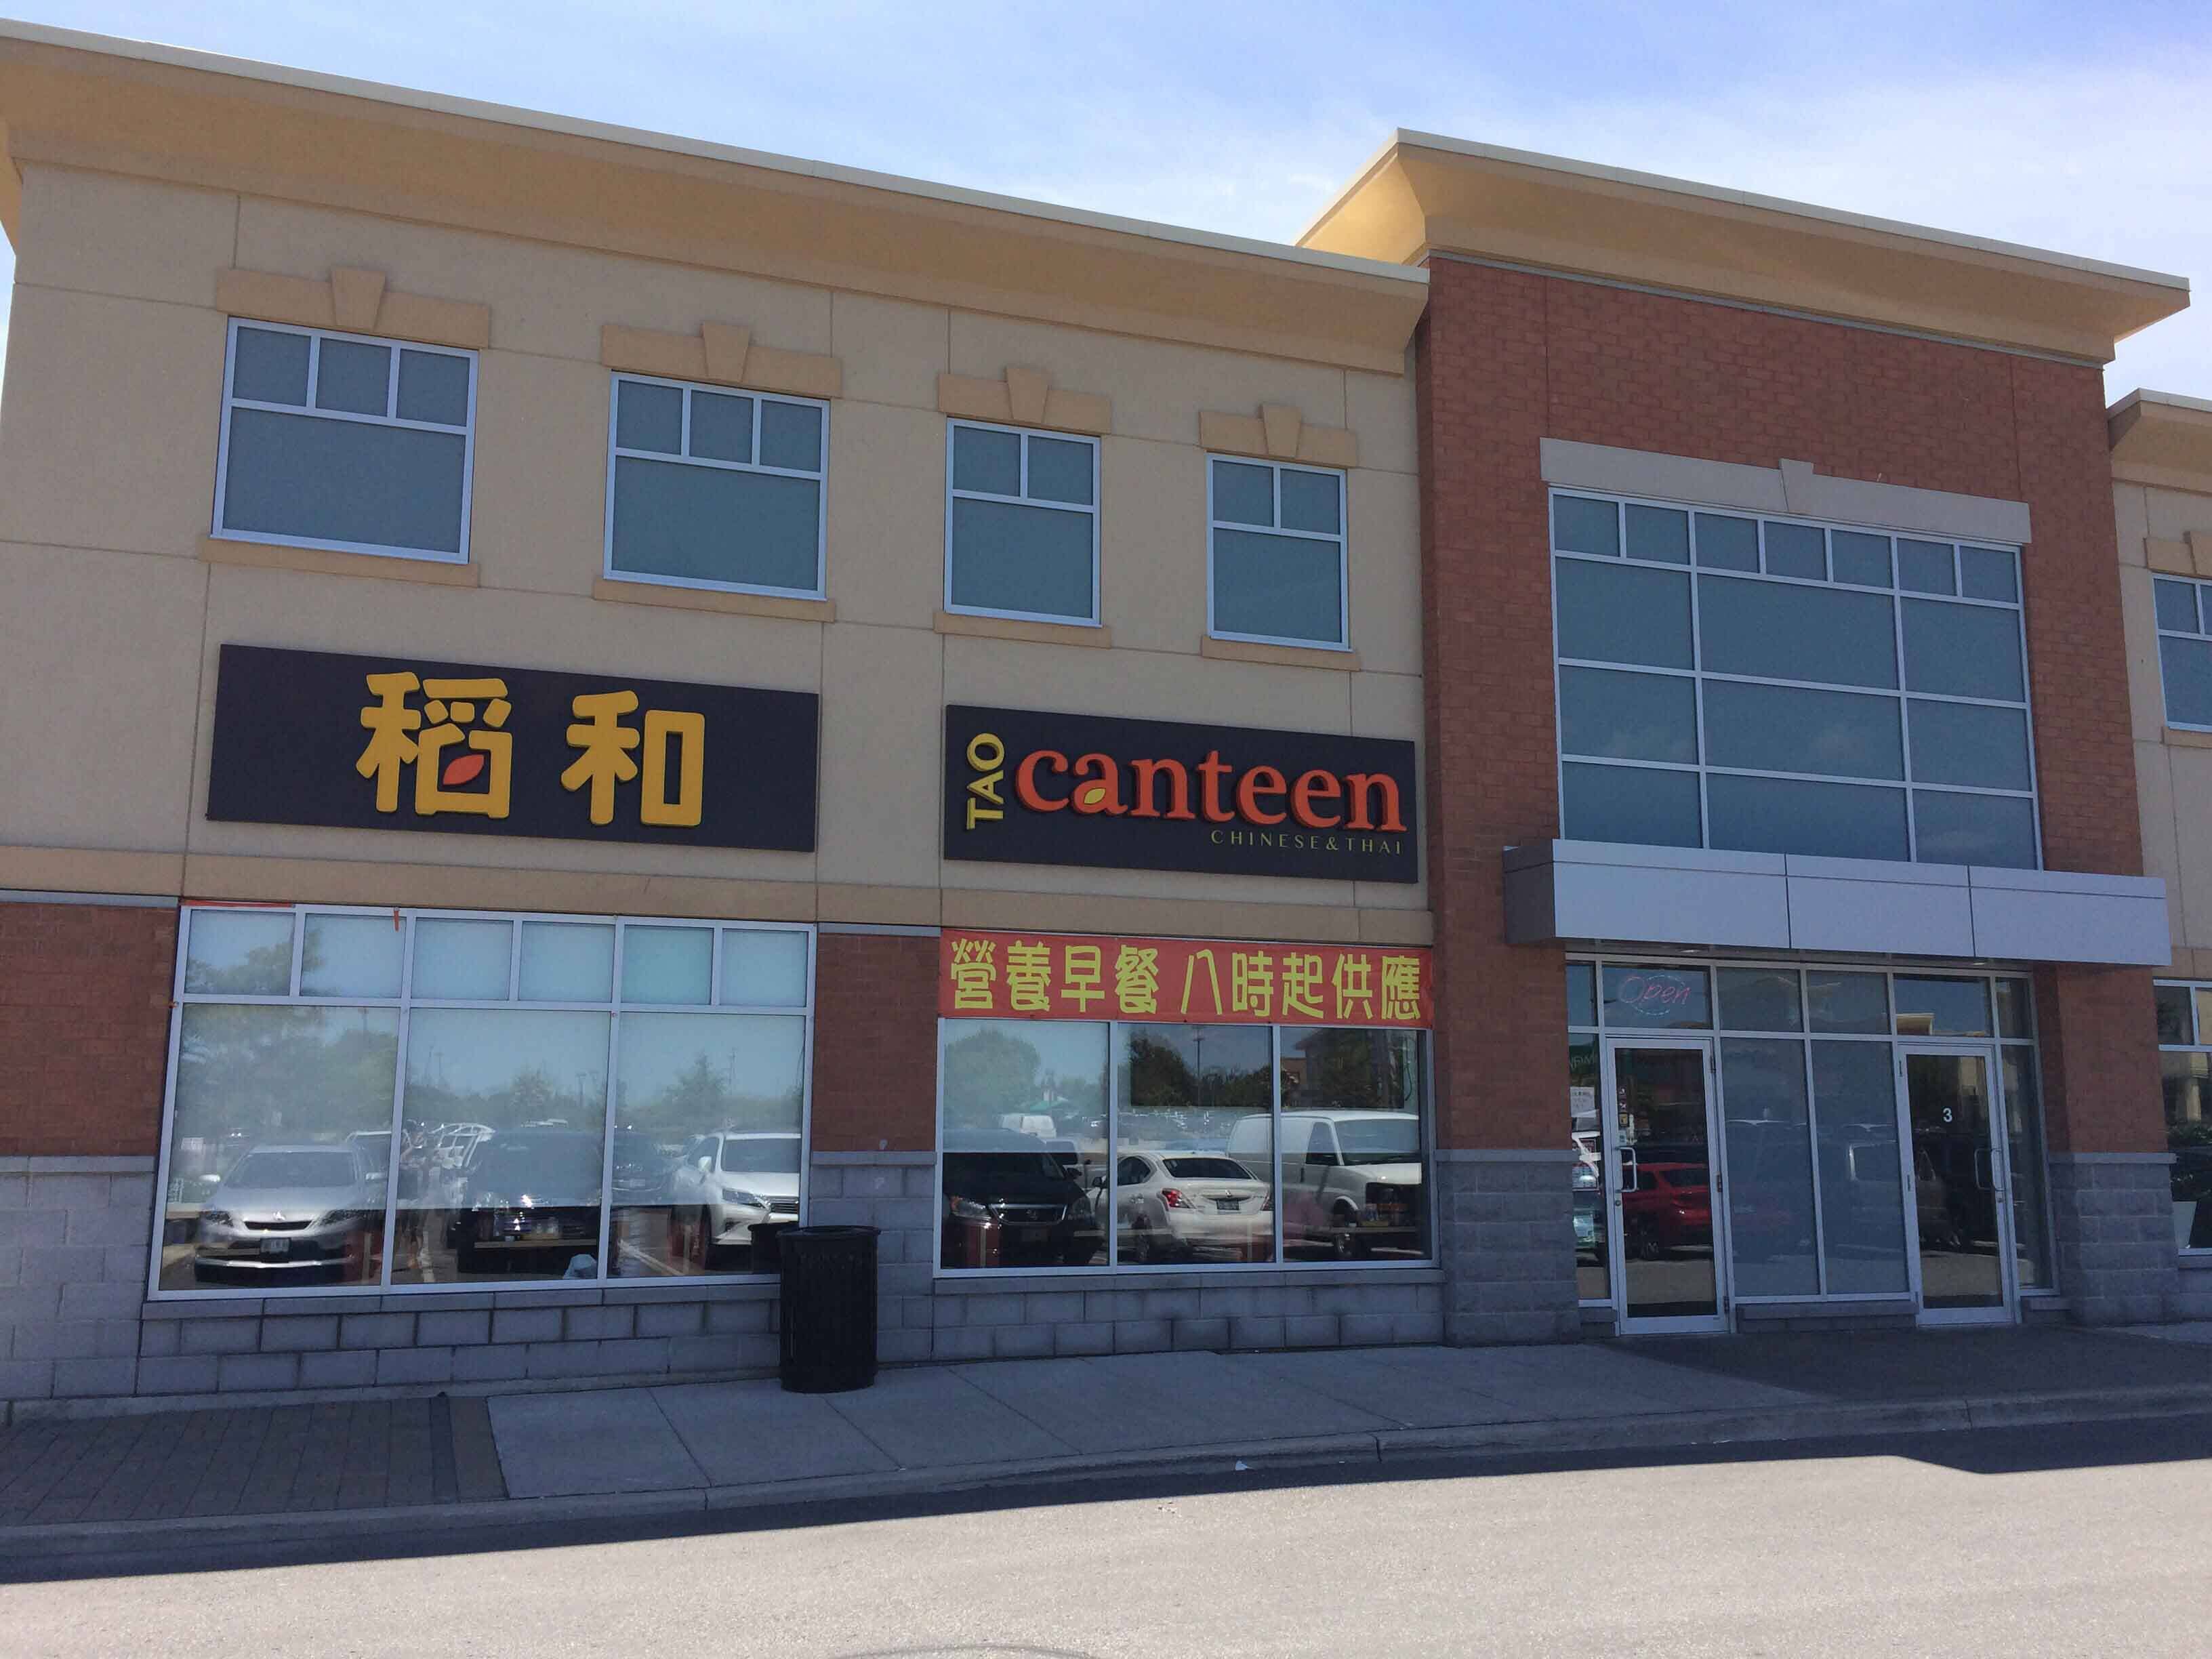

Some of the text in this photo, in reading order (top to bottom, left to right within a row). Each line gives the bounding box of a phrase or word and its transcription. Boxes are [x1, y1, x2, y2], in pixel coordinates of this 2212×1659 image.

[356, 672, 705, 825] 稻和
[966, 733, 1004, 830] TAO
[1015, 750, 1406, 832] canteen
[1943, 1107, 1952, 1122] 3
